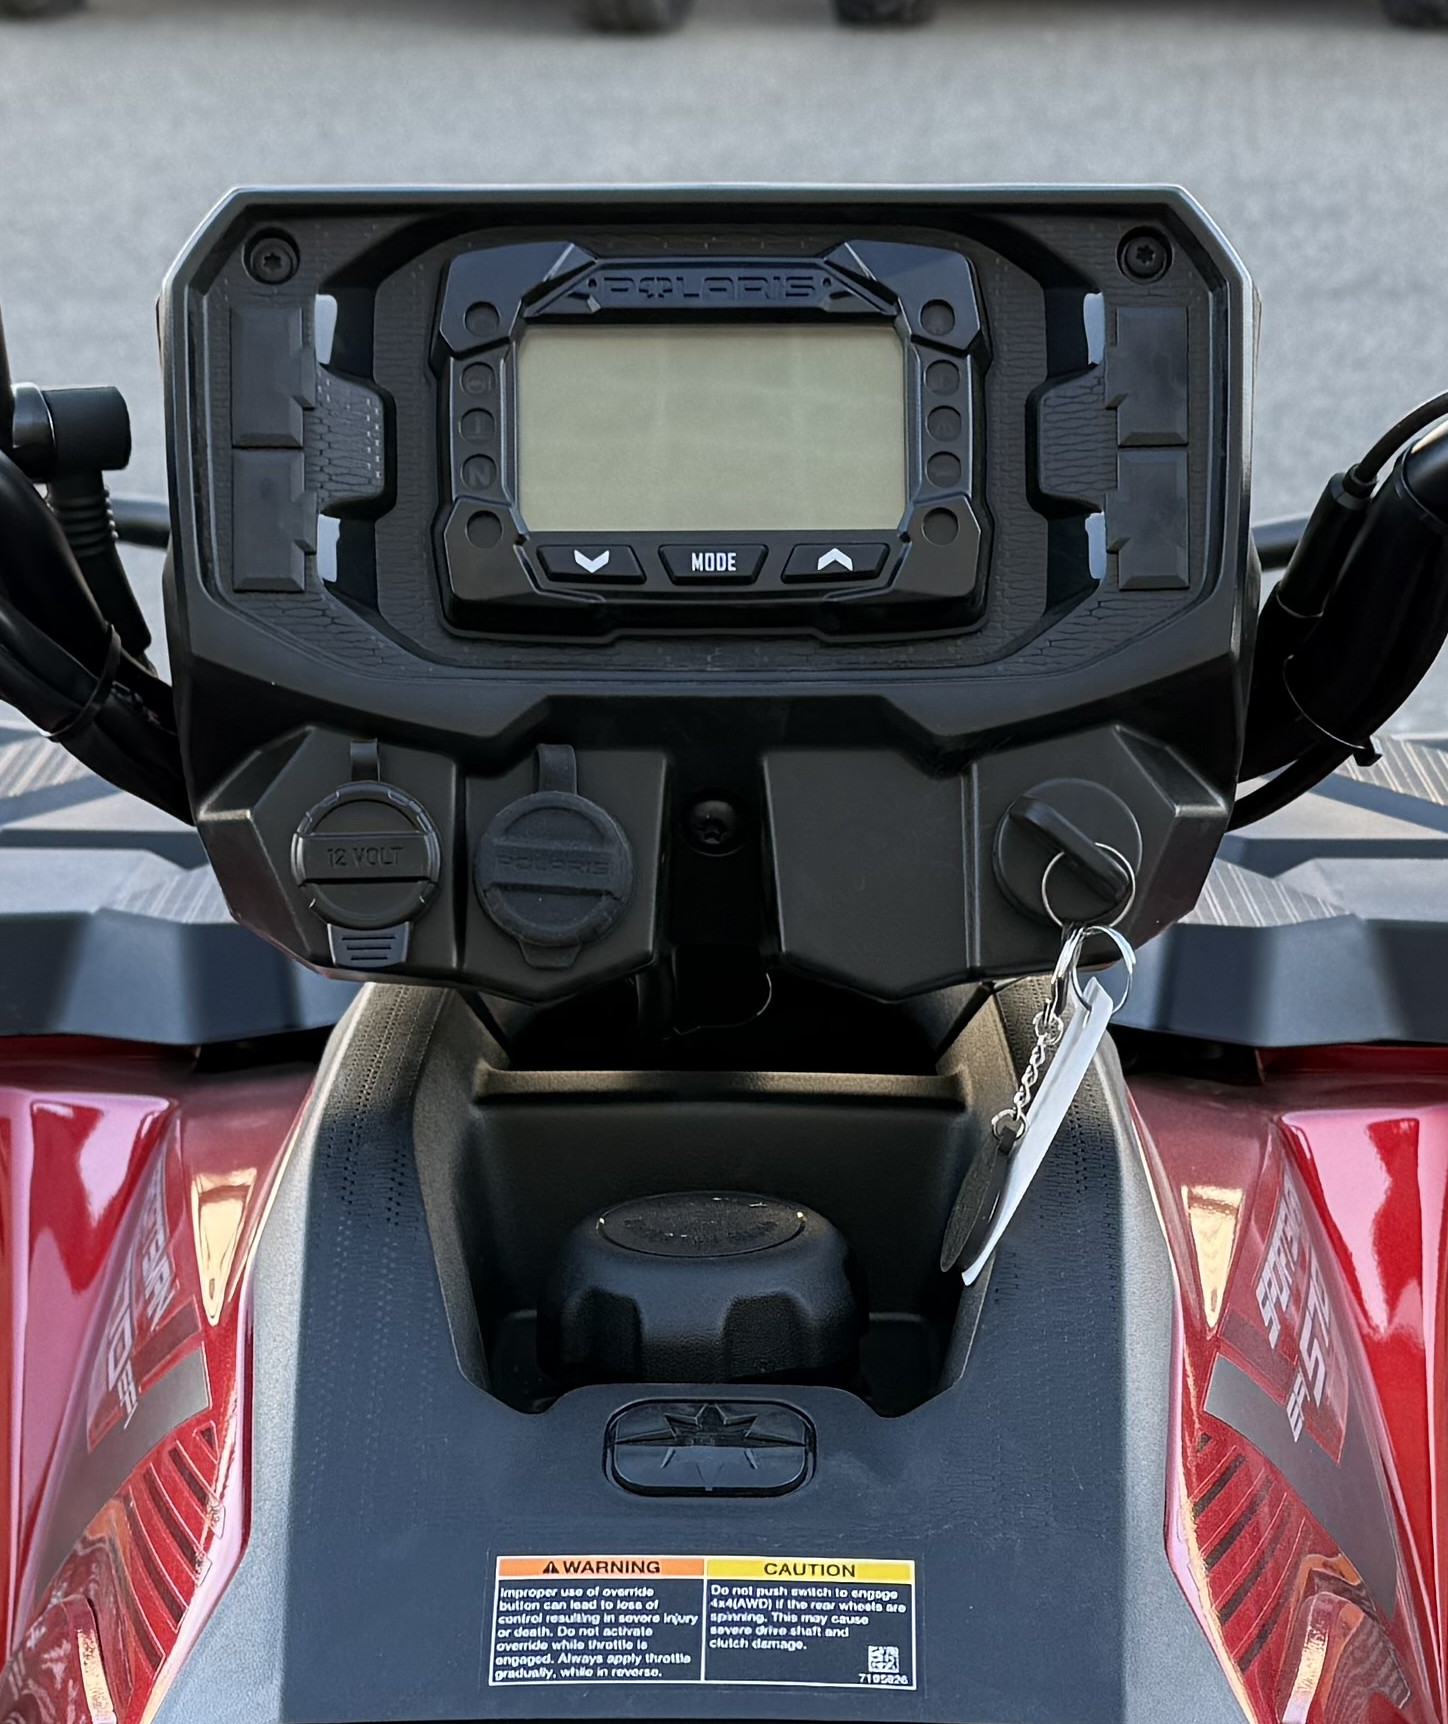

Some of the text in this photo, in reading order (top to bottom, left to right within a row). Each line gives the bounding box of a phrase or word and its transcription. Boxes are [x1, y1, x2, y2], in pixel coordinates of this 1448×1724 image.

[603, 276, 815, 299] POLARIS
[691, 552, 737, 571] MODE
[326, 845, 403, 867] 12 VOLT
[497, 853, 610, 876] POLARIS
[562, 1560, 660, 1573] WARNING
[763, 1562, 855, 1577] CAUTION
